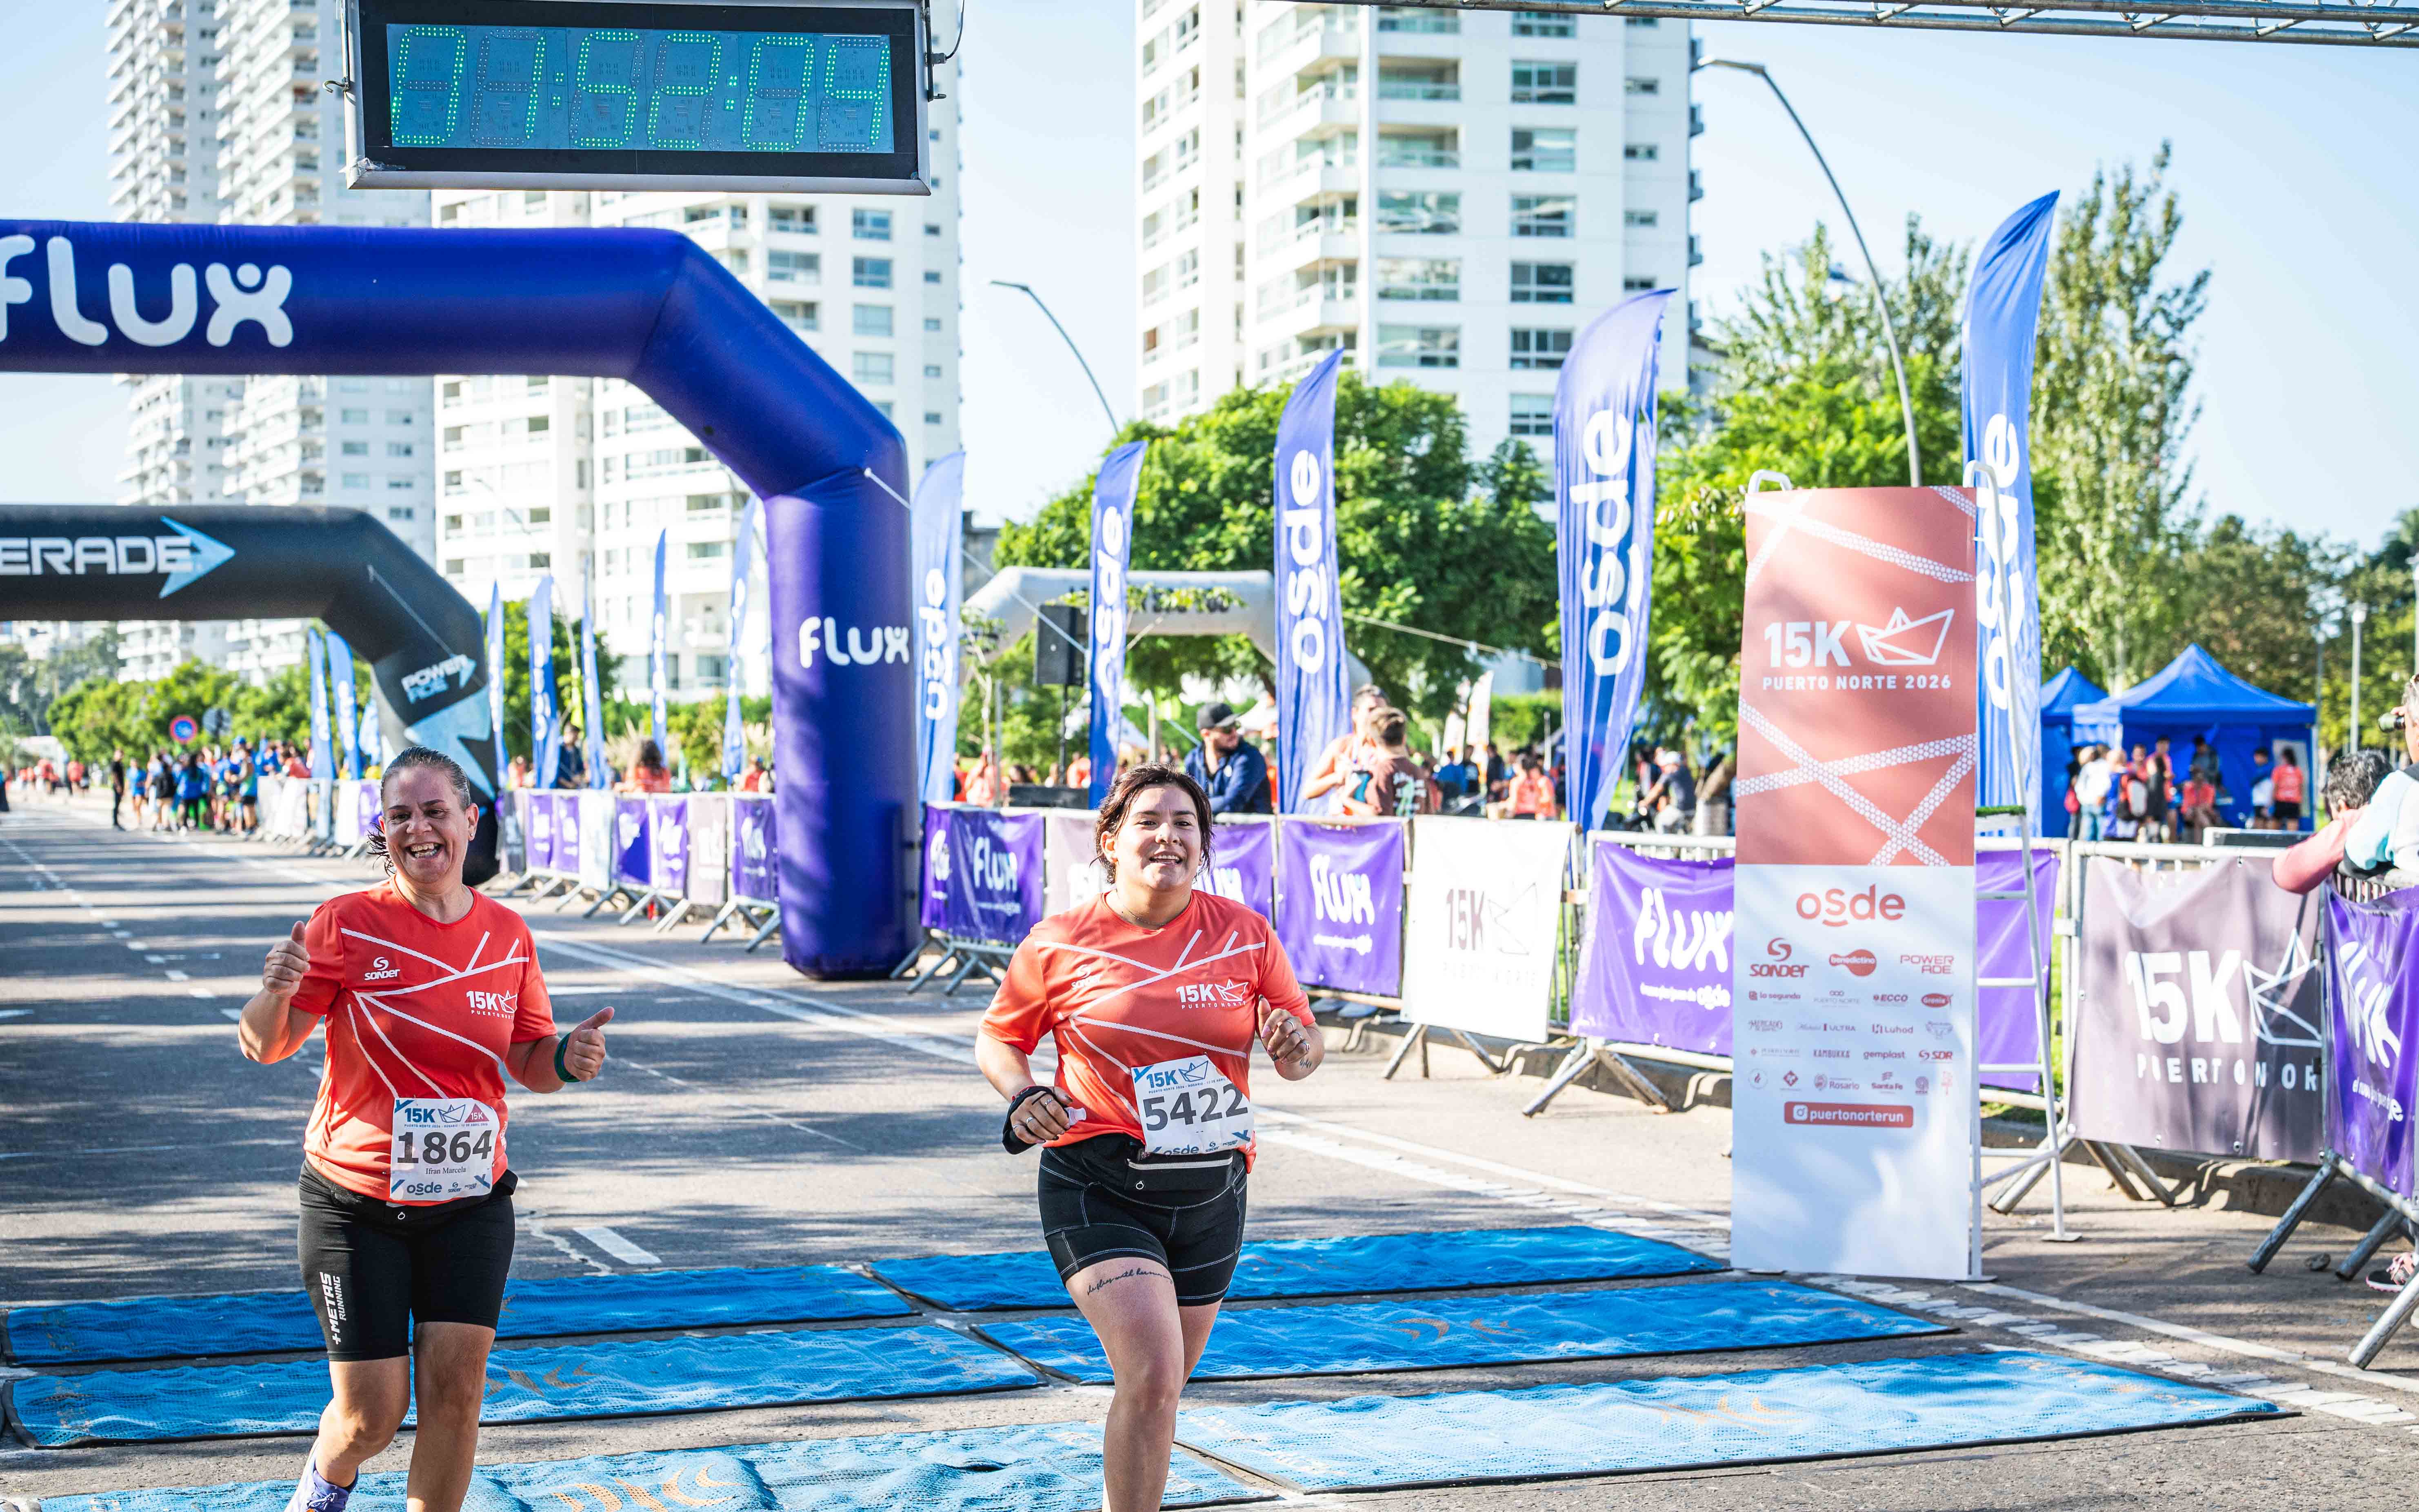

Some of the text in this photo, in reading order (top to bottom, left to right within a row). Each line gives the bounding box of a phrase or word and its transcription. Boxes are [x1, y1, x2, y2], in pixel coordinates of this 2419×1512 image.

[391, 26, 890, 152] 01:52:04
[0, 235, 293, 347] flux
[1284, 449, 1328, 674] osde
[1570, 409, 1644, 676] osde
[1976, 413, 2025, 710] osde
[1095, 506, 1123, 699] osde
[799, 615, 910, 669] flux
[1764, 620, 1852, 668] 15K
[1763, 674, 1952, 691] PUERTO NORTE 2026
[1309, 853, 1375, 926] flux
[1796, 884, 1906, 927] osde
[1446, 888, 1484, 950] 15K
[1634, 887, 1734, 972] flux
[1900, 955, 1954, 964] POWER
[466, 990, 499, 1011] 15K
[1175, 984, 1217, 1003] 15K
[1880, 994, 1908, 1002] ECCO
[2124, 950, 2242, 1044] 15K
[1813, 1049, 1850, 1058] KAMBUKKA
[1863, 1050, 1905, 1060] gemplast
[1932, 1050, 1953, 1060] SDR
[1146, 1069, 1178, 1088] 15K
[1829, 1081, 1859, 1090] Rosario
[404, 1108, 436, 1123] 15K
[1143, 1083, 1248, 1131] 5422
[1810, 1109, 1904, 1123] puertonorterun
[397, 1130, 492, 1164] 1864
[1163, 1144, 1200, 1156] osde
[406, 1181, 442, 1195] osde
[333, 1276, 347, 1321] RUNNING
